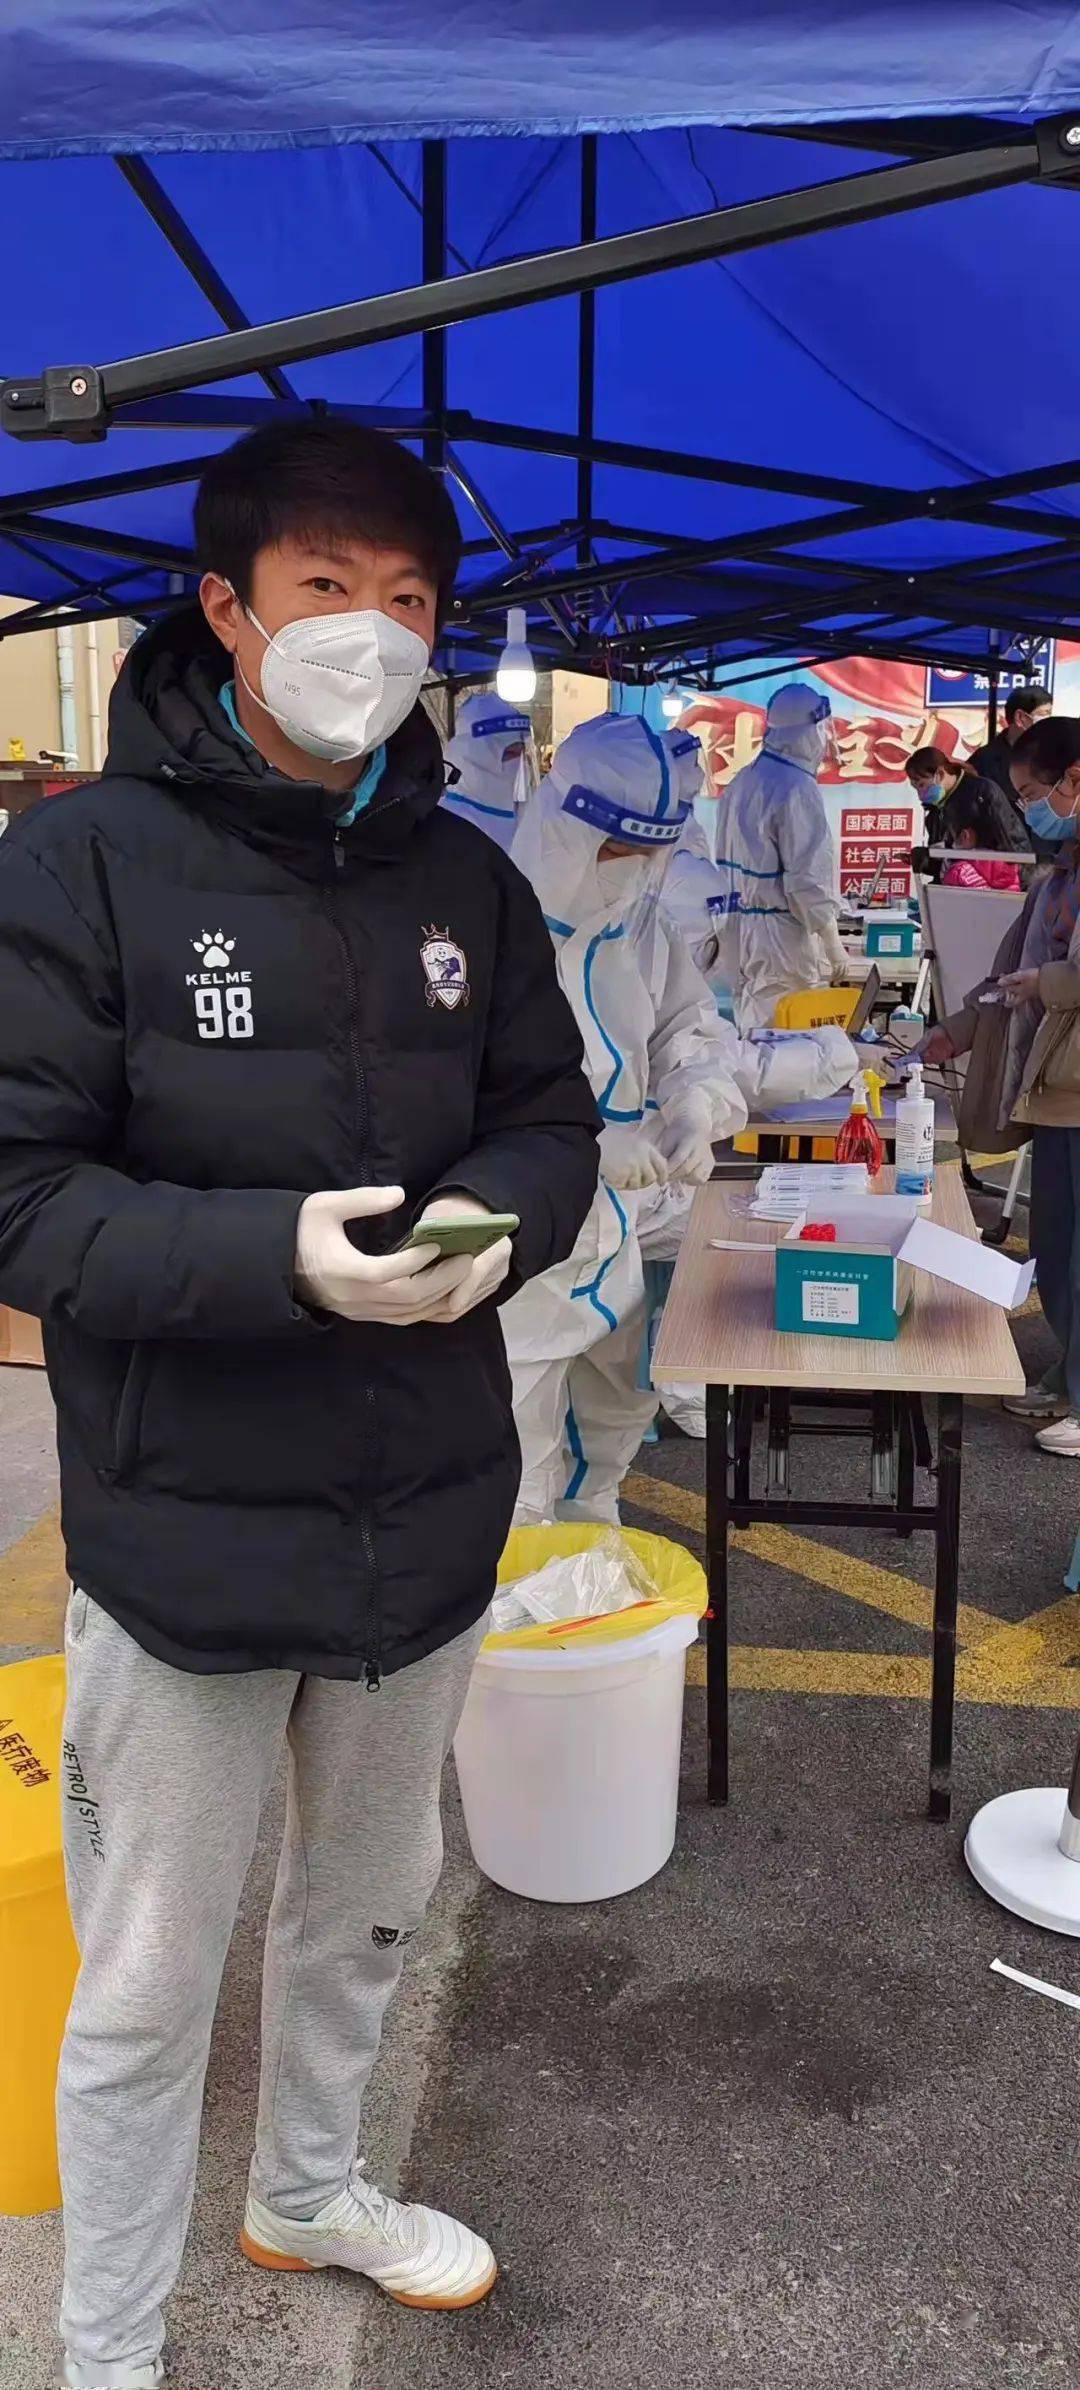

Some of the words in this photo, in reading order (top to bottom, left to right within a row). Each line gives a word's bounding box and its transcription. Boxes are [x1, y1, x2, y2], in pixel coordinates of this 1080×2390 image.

[284, 680, 302, 697] N95
[846, 814, 908, 831] 国家层面
[187, 971, 252, 986] KELME
[194, 986, 255, 1039] 98
[0, 1733, 52, 1787] 医疗废物
